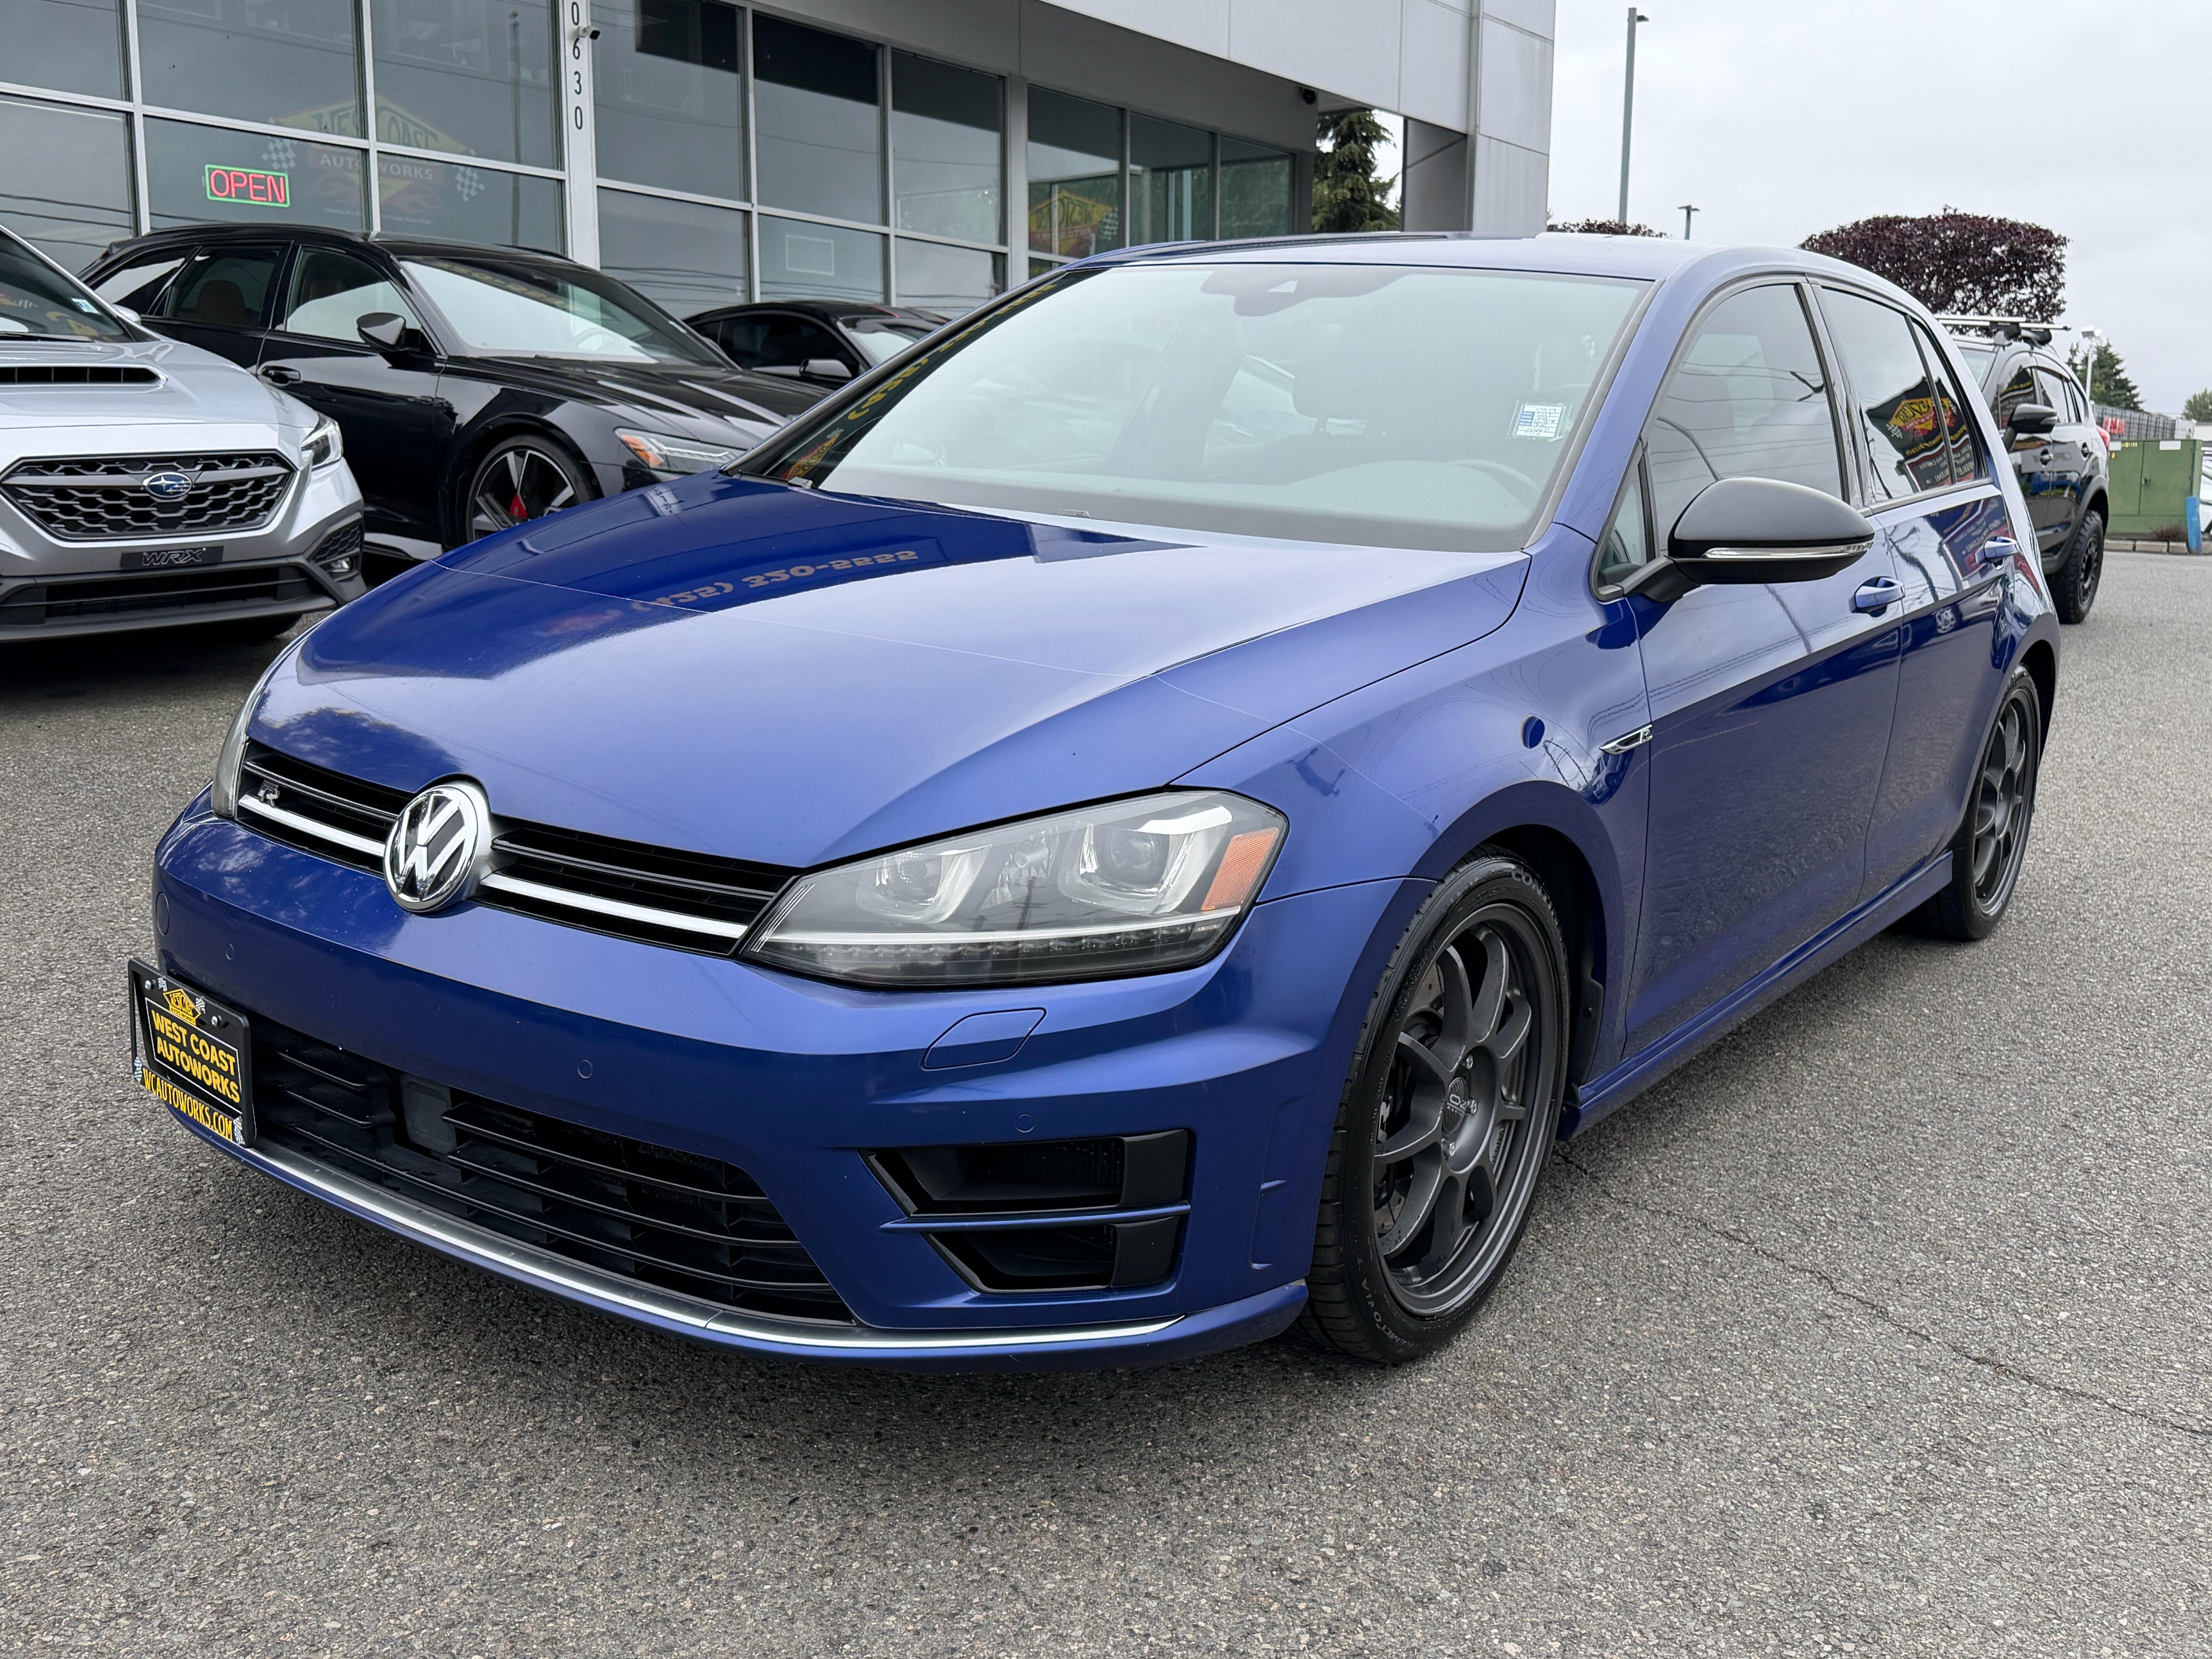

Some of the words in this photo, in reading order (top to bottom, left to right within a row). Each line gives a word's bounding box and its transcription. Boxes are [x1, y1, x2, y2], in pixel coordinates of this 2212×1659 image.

[210, 170, 285, 203] OPEN
[143, 549, 203, 567] WRX
[151, 1009, 187, 1047] WEST
[190, 1034, 235, 1076] COAST
[157, 1036, 240, 1104] AUTOWORKS
[143, 1067, 233, 1142] WCAUTOWORKS.COM
